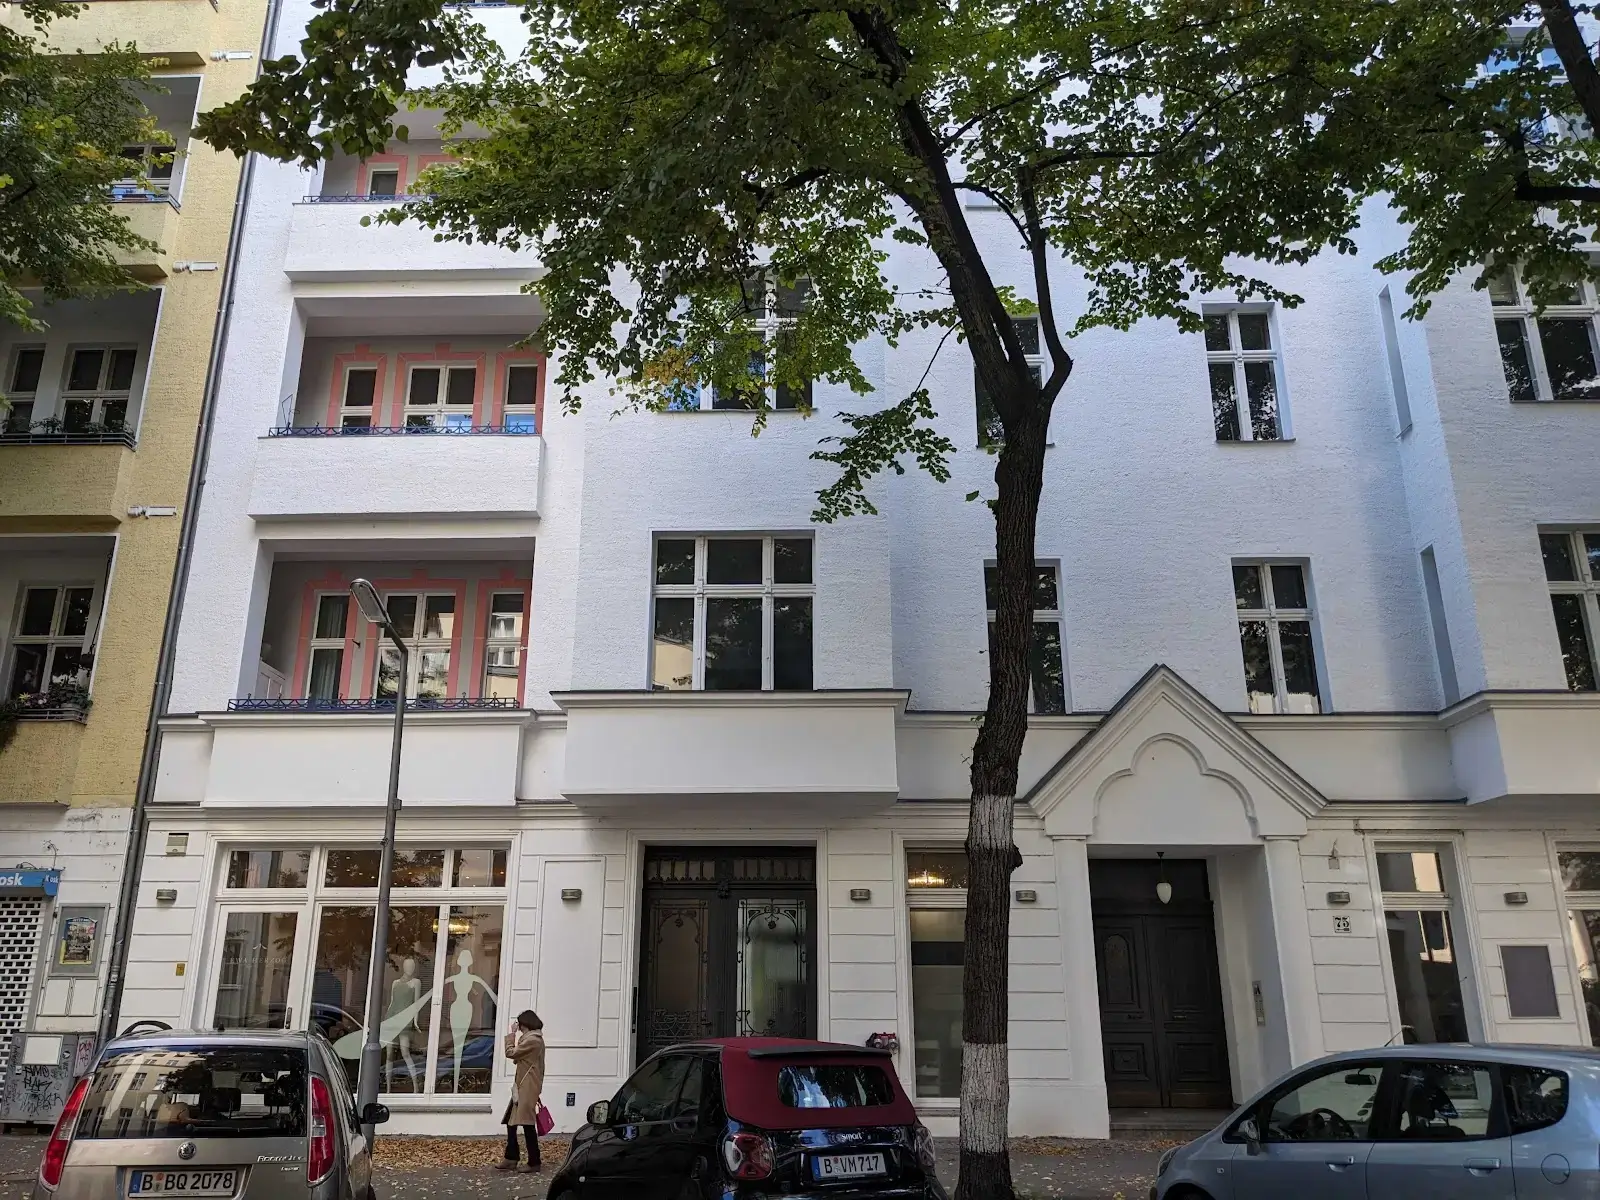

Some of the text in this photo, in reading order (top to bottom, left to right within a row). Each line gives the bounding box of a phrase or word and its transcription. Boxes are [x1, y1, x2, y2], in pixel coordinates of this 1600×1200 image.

[841, 1132, 862, 1140] smart
[824, 1156, 879, 1174] B VM 717
[141, 1172, 233, 1191] B BQ 2078
